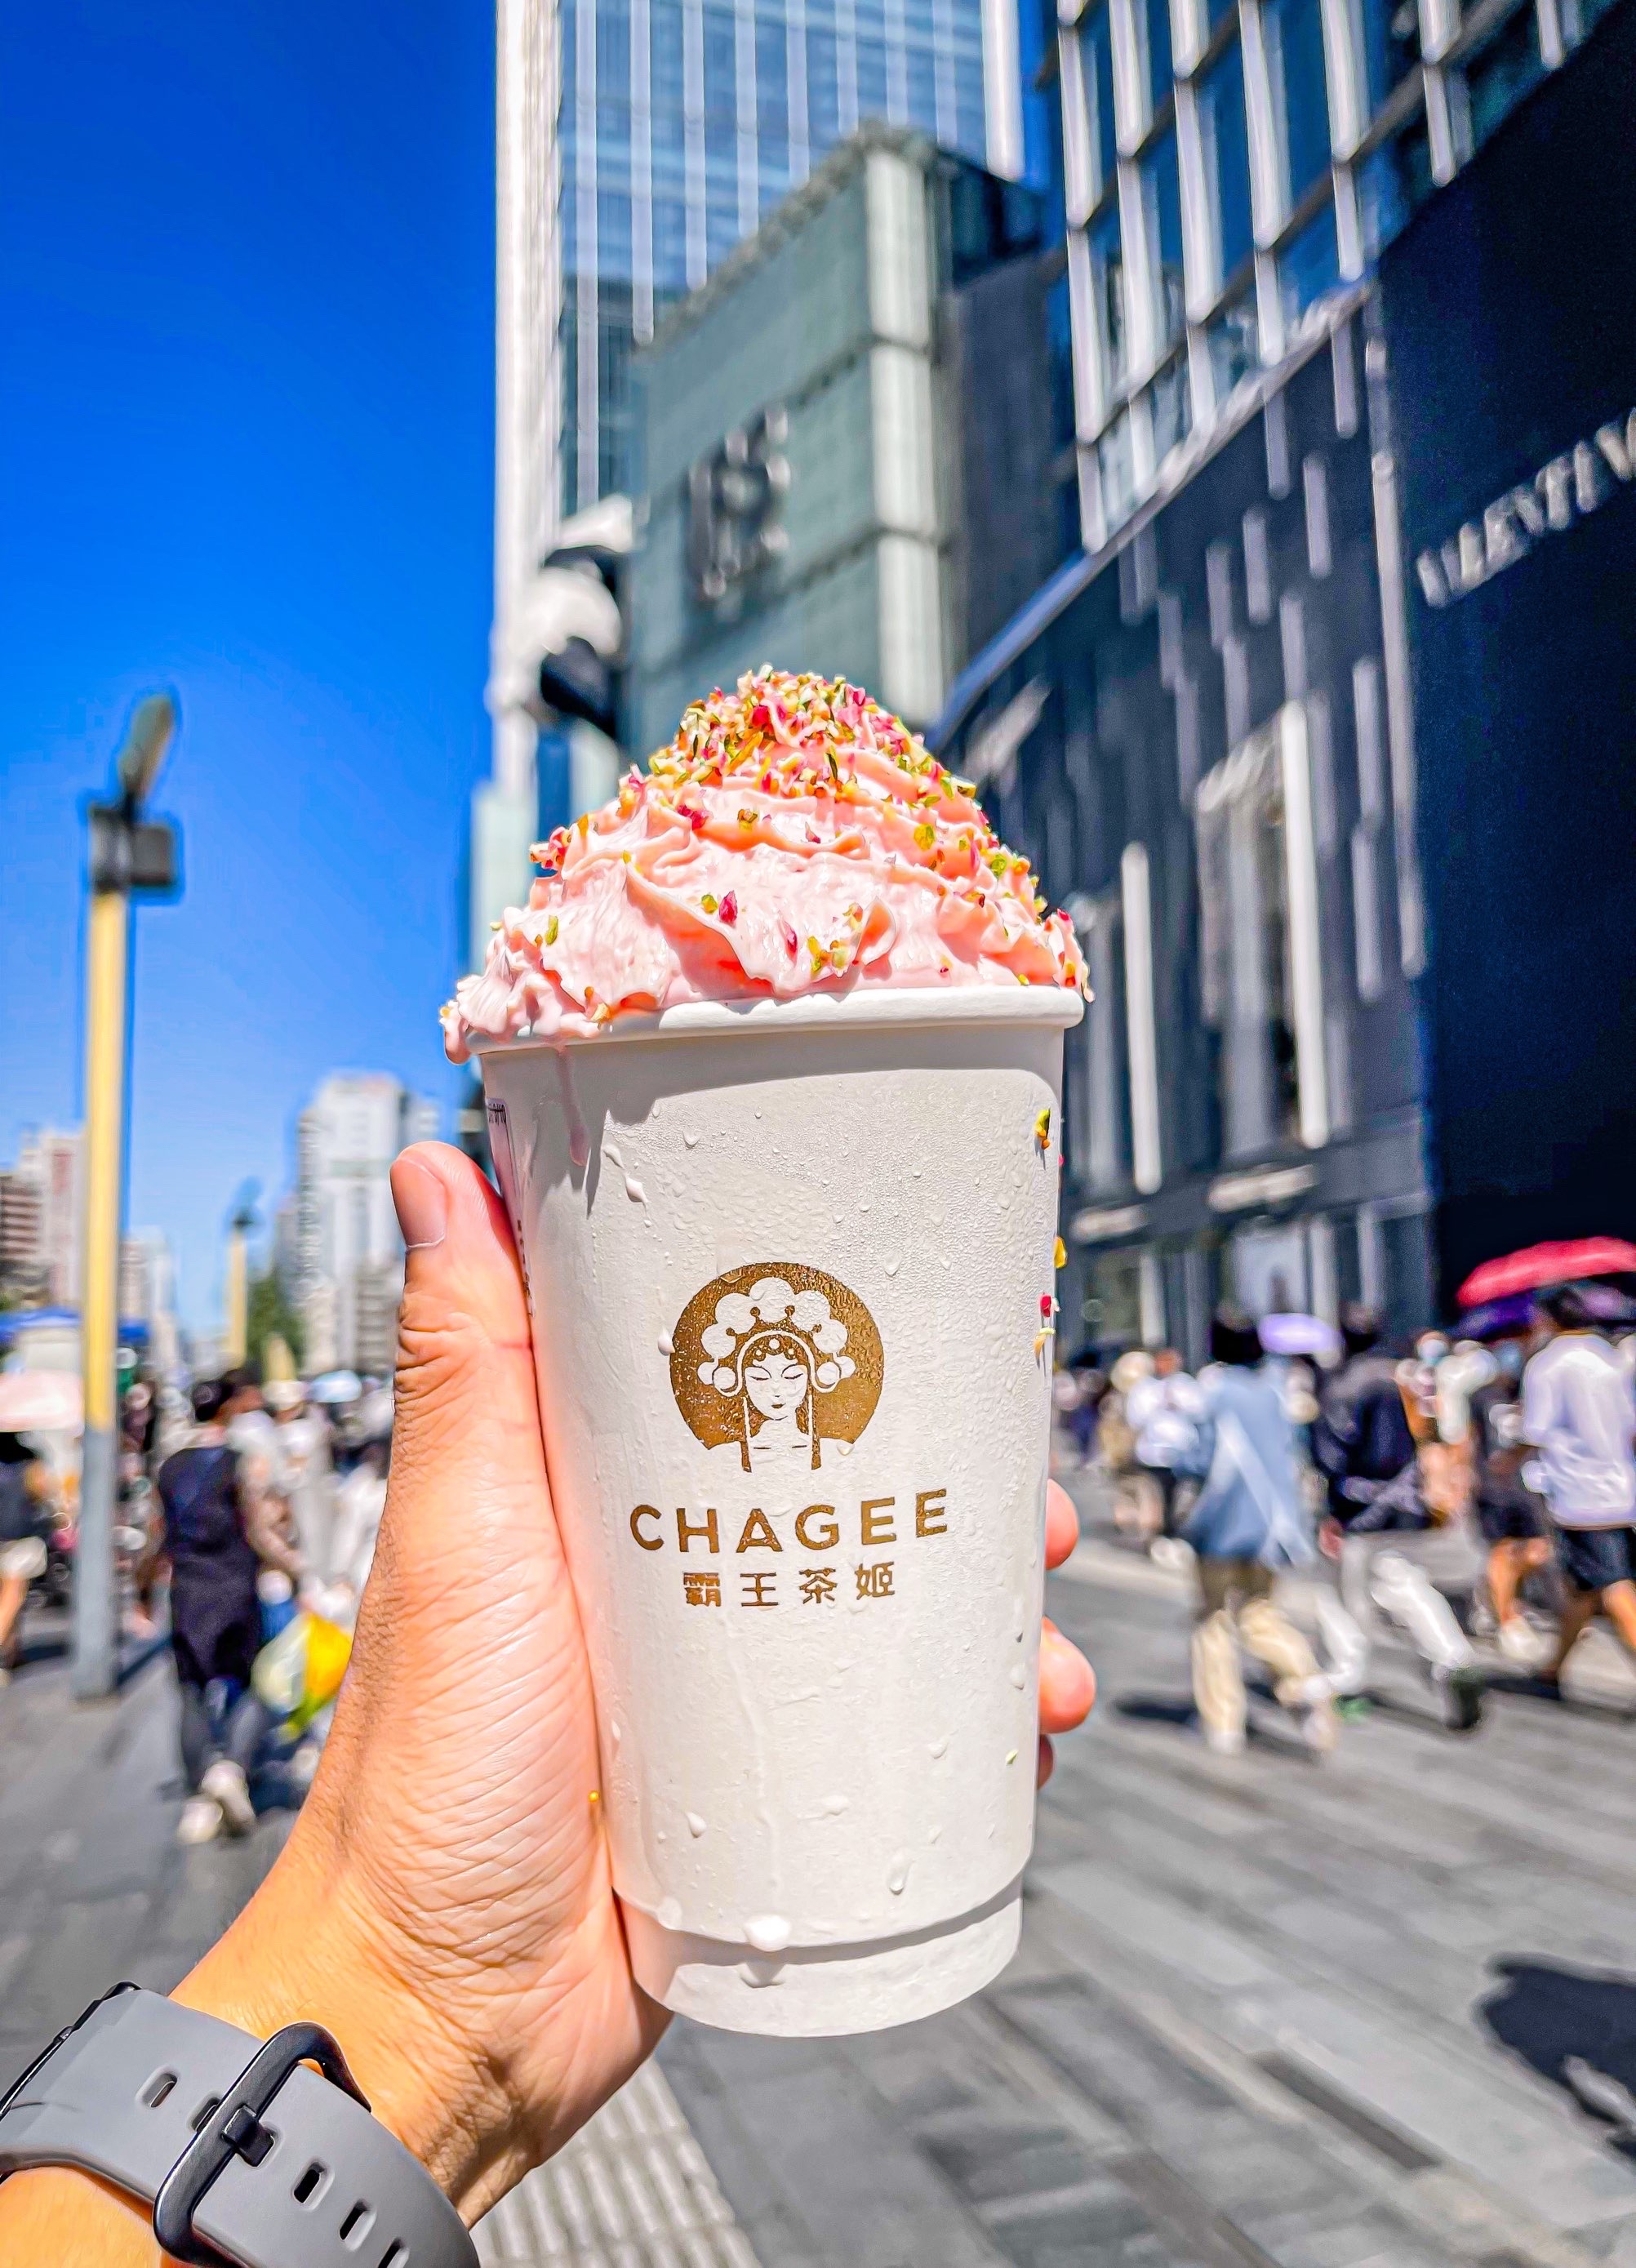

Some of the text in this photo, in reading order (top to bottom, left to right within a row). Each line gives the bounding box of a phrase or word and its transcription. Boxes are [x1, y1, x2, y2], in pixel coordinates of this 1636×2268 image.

[629, 1488, 948, 1554] CHAGEE
[682, 1561, 896, 1608] 霸王茶姬
